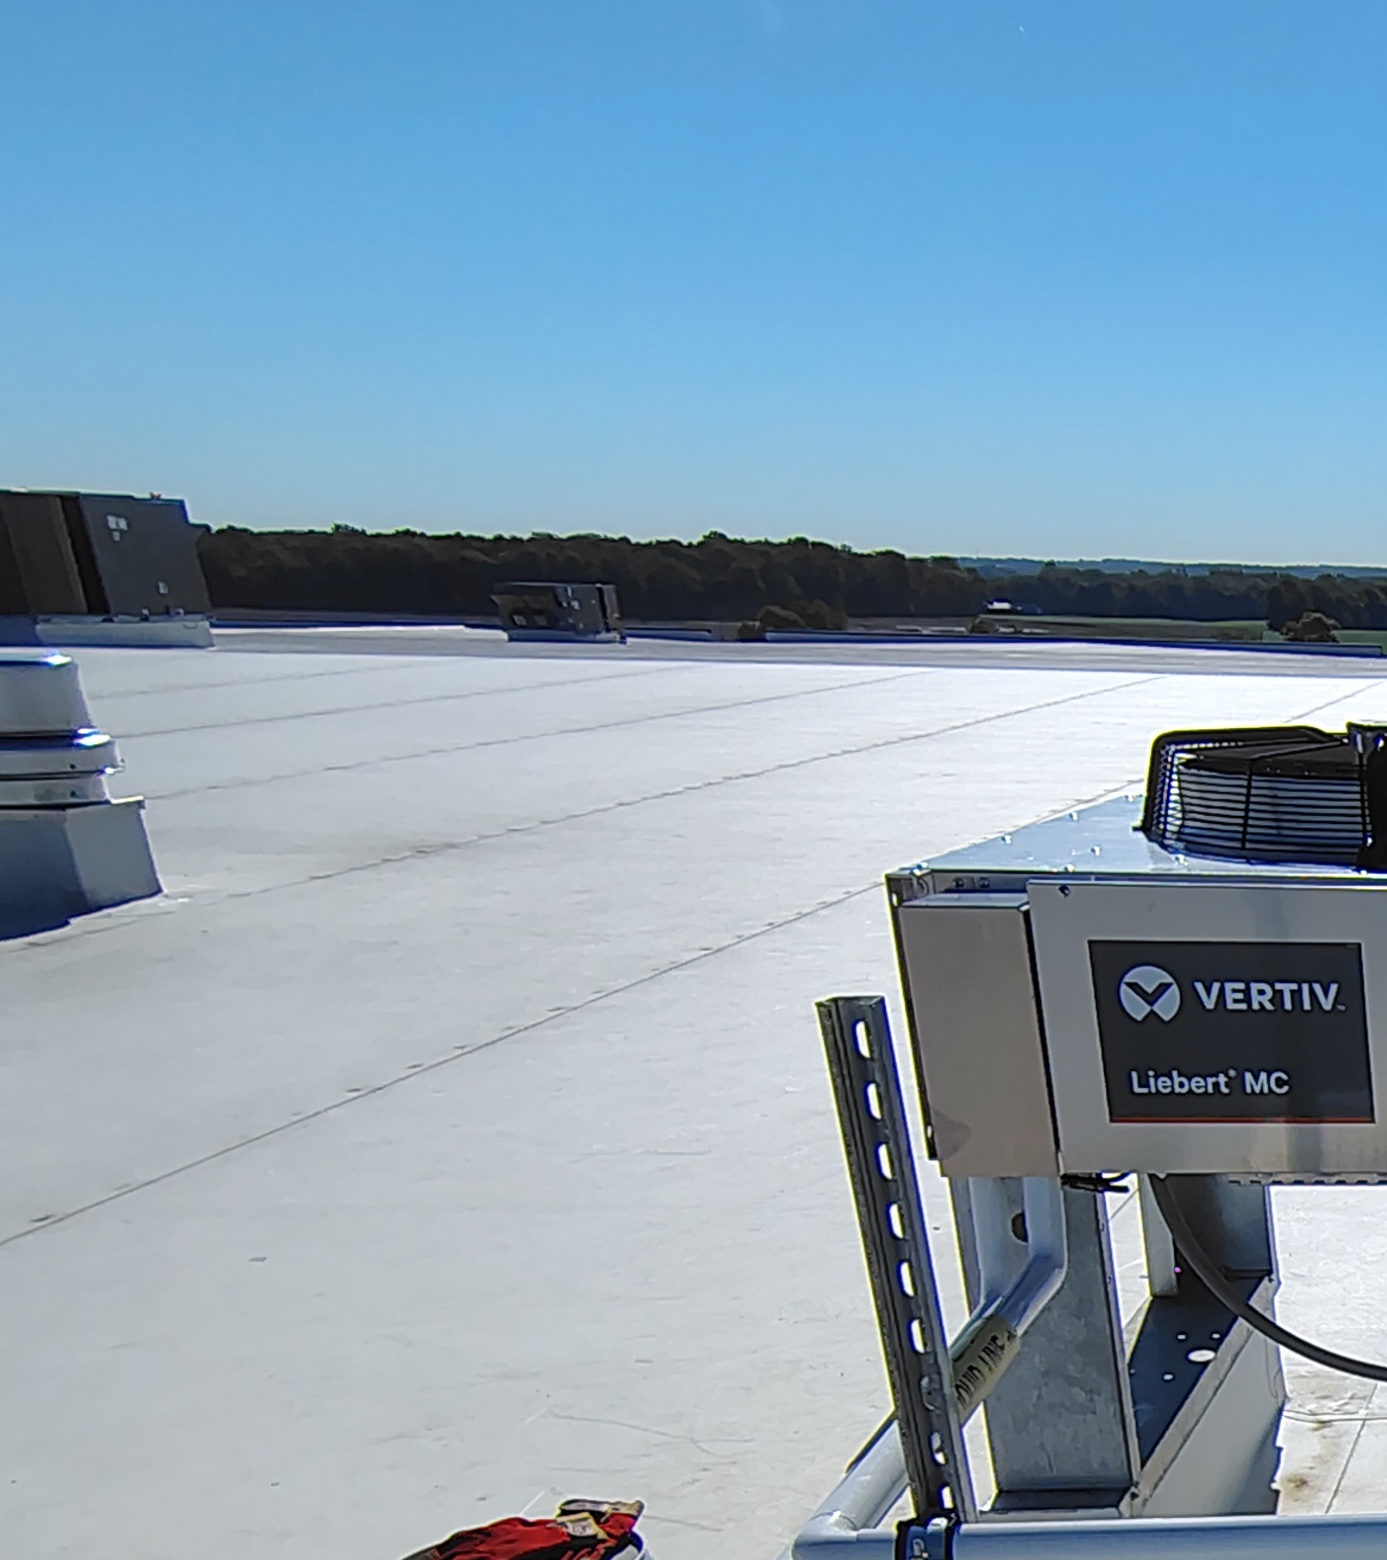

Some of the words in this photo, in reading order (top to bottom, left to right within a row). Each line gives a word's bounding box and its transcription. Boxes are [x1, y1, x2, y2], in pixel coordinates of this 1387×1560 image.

[1193, 981, 1339, 1012] VERTIV
[1130, 1070, 1230, 1094] Liebert
[1244, 1071, 1289, 1095] MC
